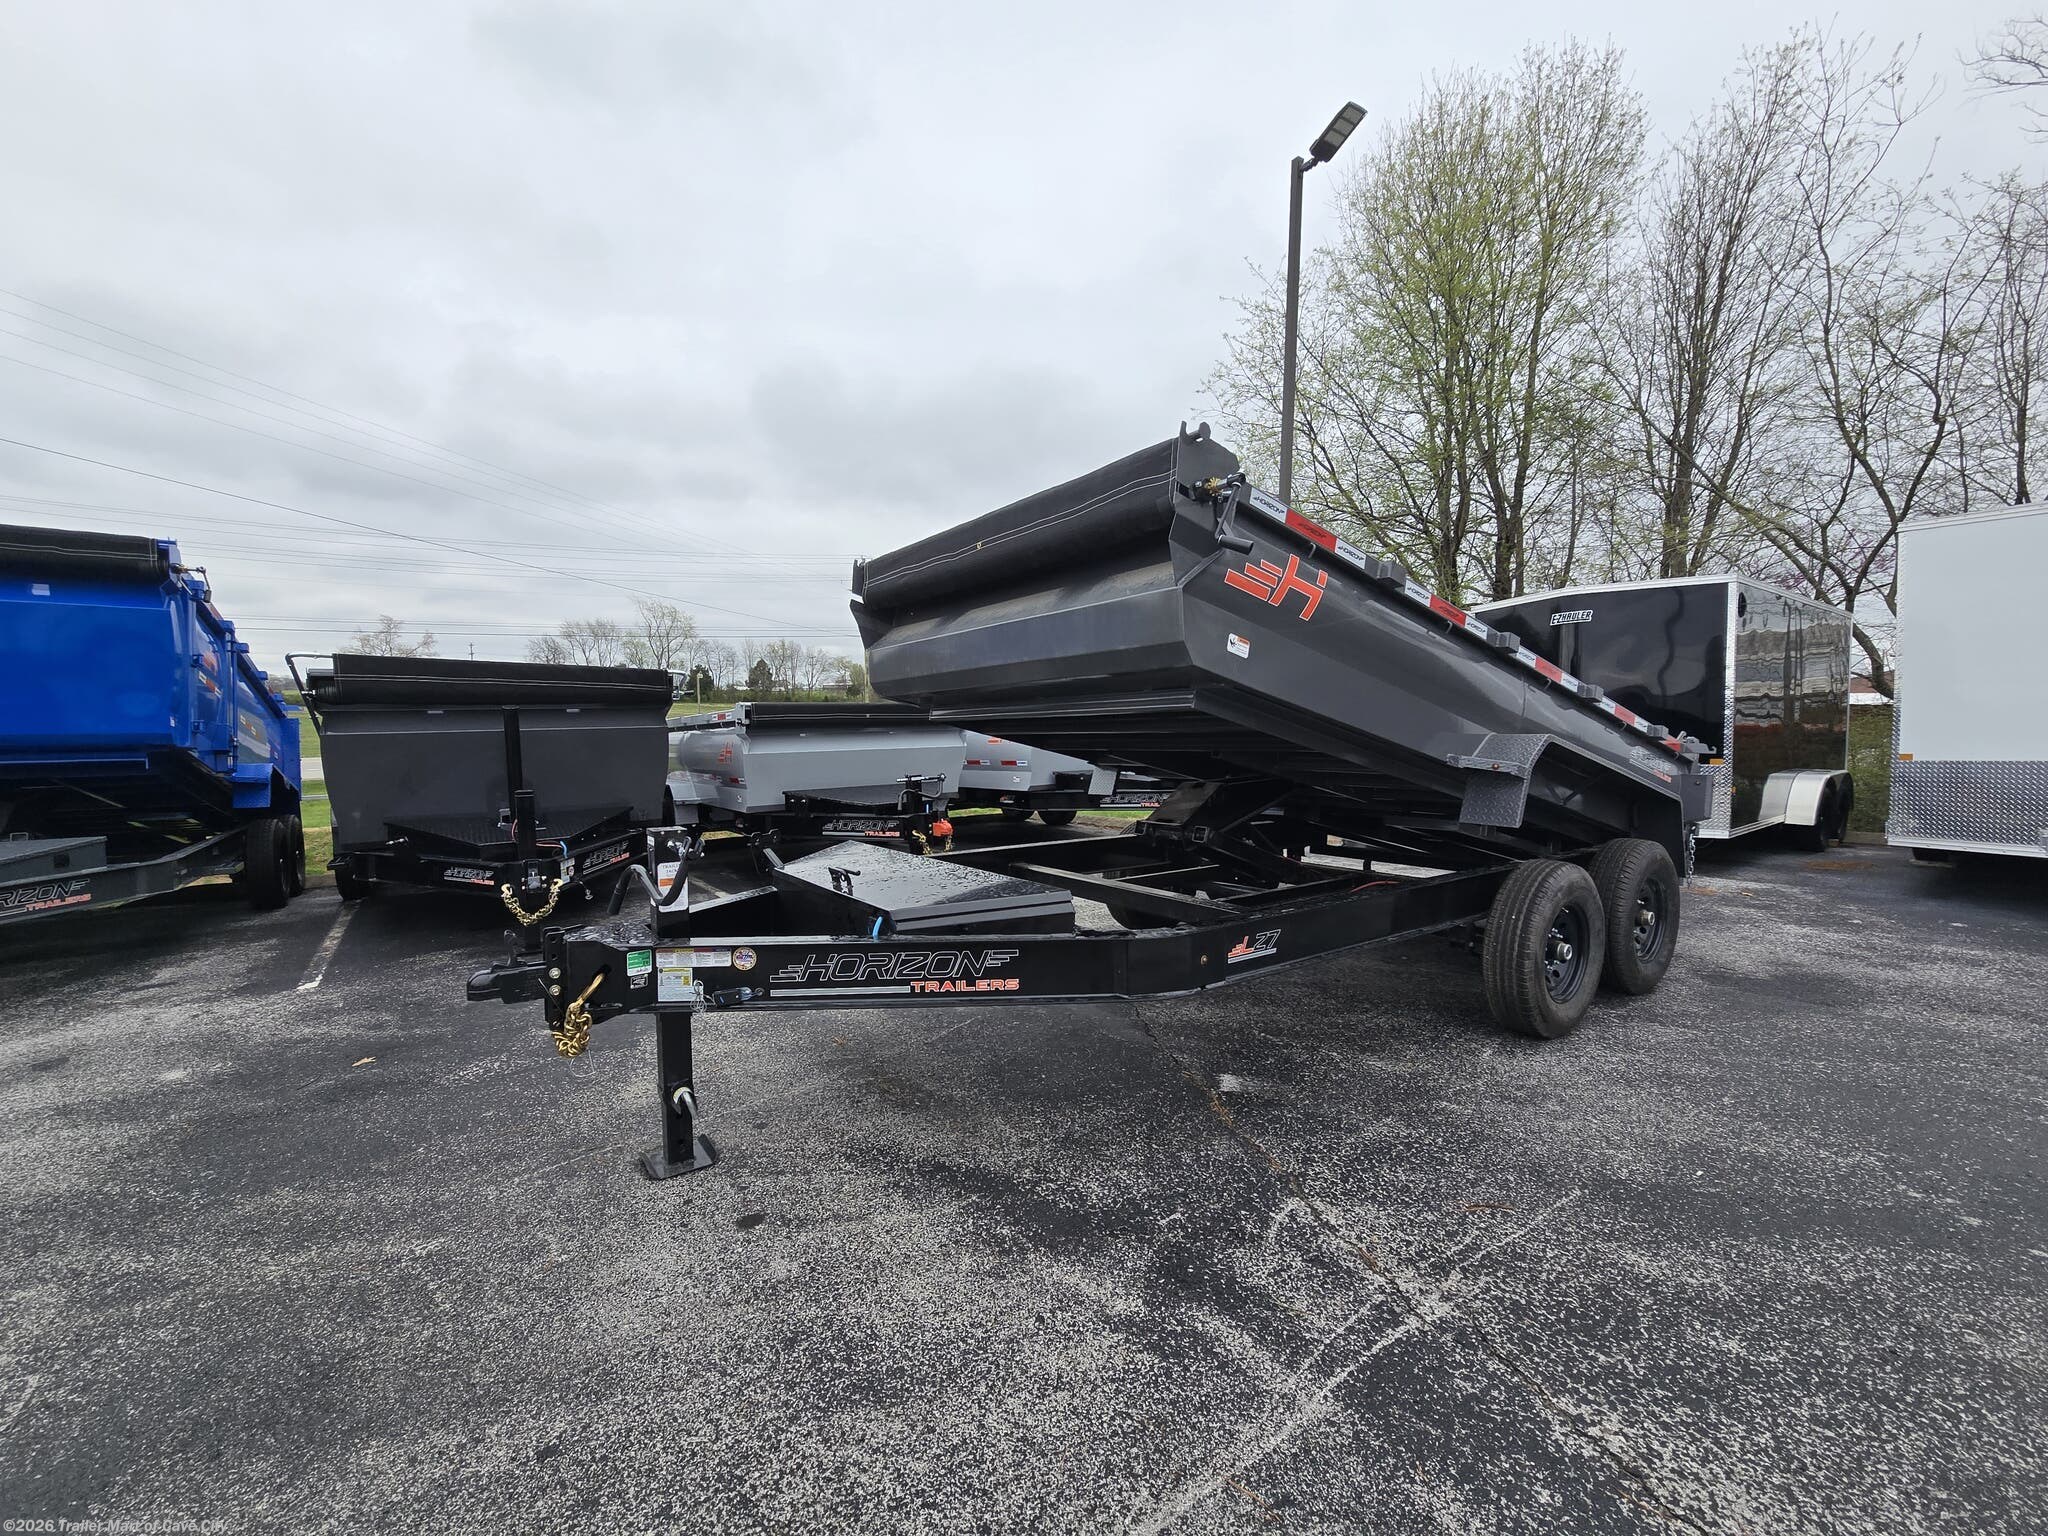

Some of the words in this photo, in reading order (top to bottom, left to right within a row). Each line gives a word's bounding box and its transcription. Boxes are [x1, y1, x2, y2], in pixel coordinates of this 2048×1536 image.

[830, 819, 891, 831] HORIZON
[797, 951, 992, 982] HORIZON
[910, 978, 1020, 993] TRAILERS
